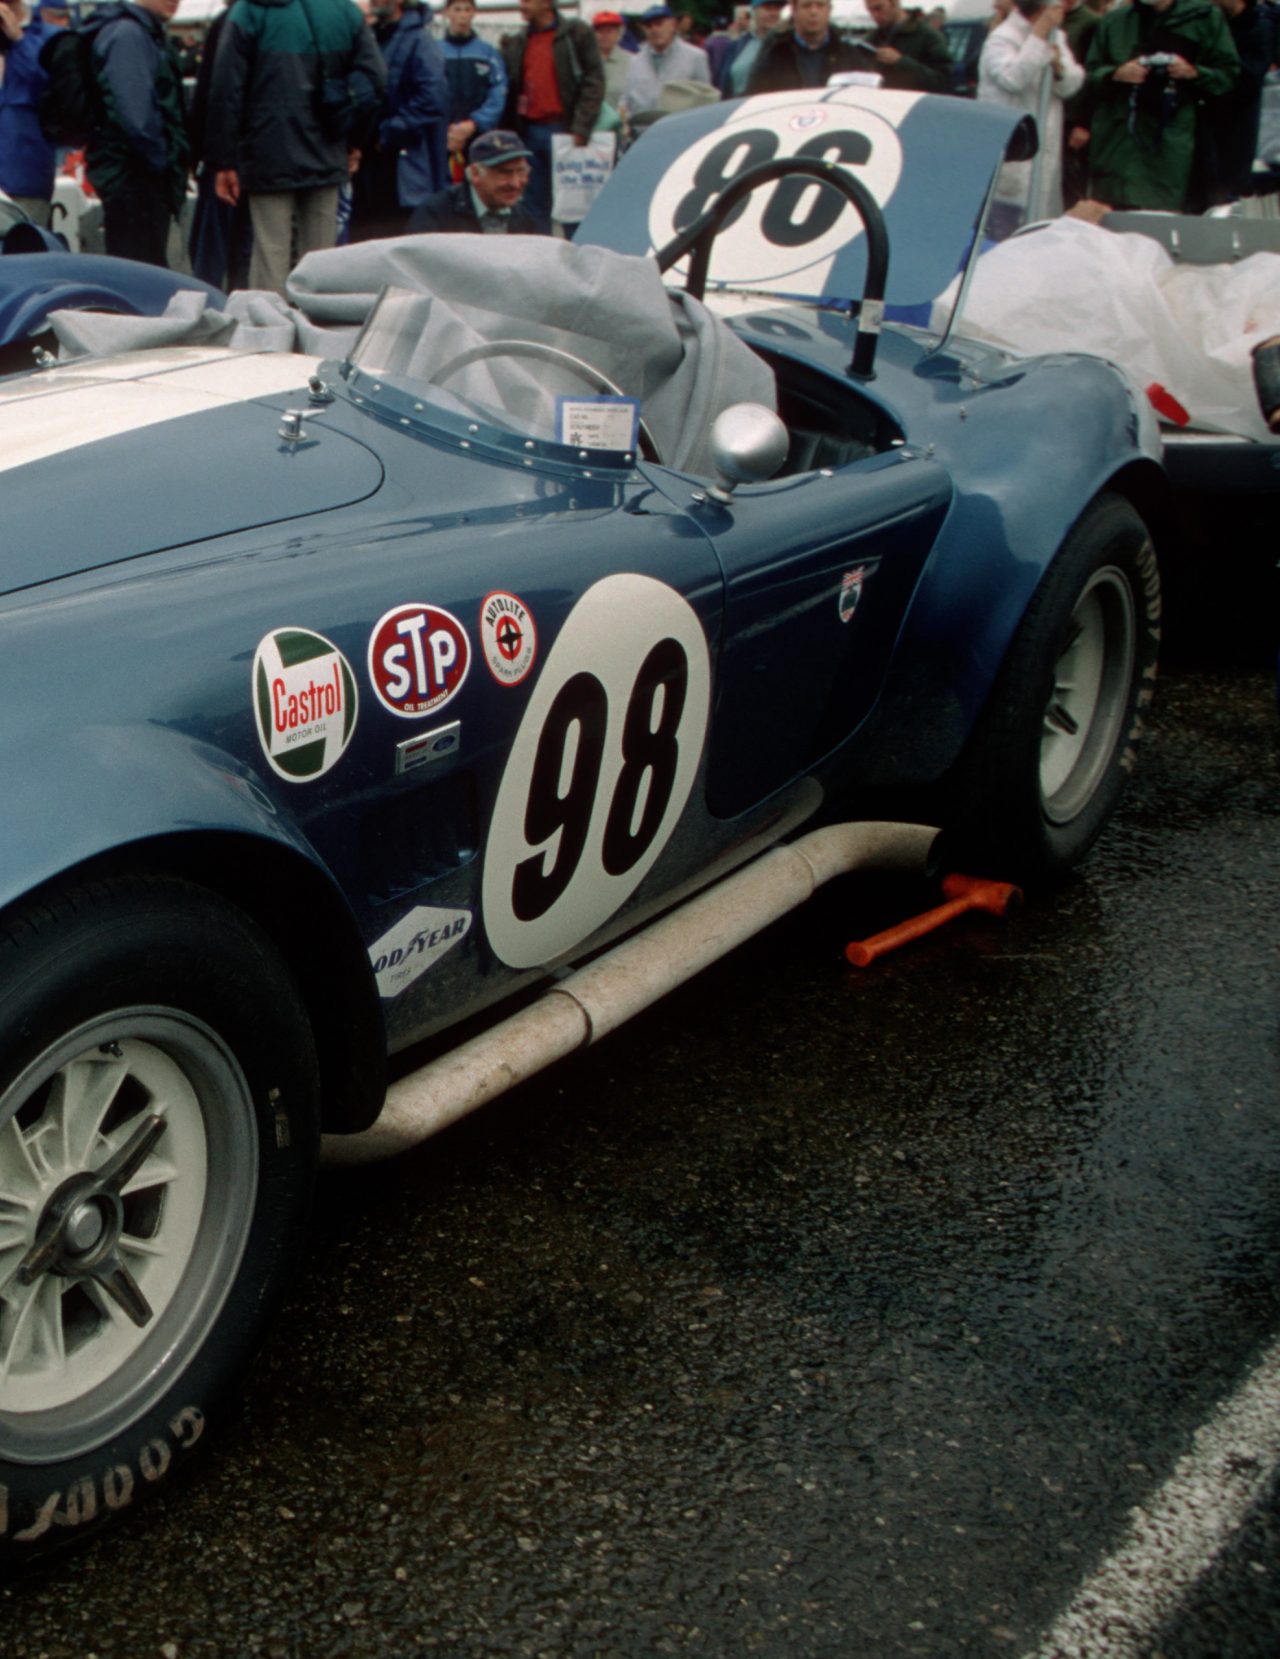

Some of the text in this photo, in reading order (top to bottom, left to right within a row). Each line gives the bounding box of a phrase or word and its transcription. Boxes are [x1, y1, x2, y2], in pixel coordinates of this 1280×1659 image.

[485, 598, 526, 627] AUTOLITE
[383, 613, 456, 699] STP
[272, 662, 341, 733] Castrol
[404, 689, 449, 711] OIL TREATMENT
[286, 722, 328, 744] MOTOR OIL
[511, 637, 688, 922] 98
